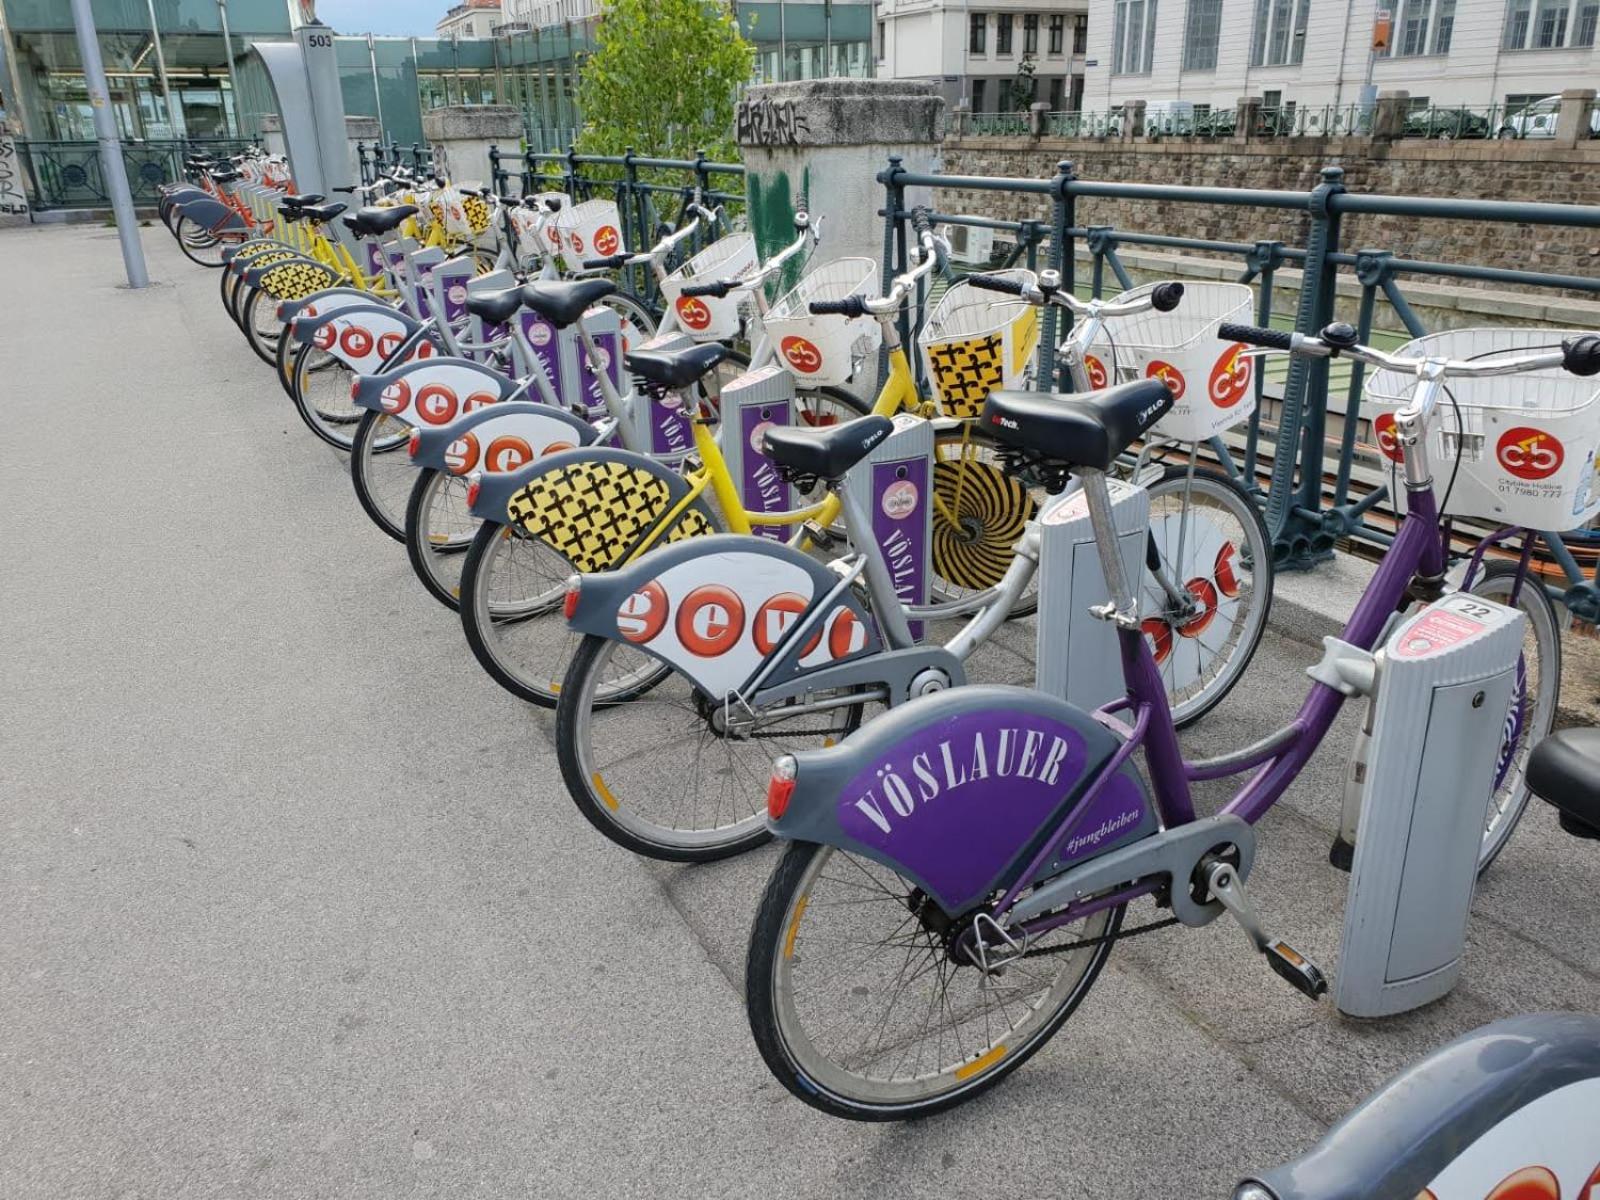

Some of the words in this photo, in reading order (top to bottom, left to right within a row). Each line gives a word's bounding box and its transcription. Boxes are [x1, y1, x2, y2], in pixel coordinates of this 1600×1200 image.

[309, 35, 332, 48] 503
[1498, 484, 1511, 493] 01
[1542, 490, 1562, 499] 777
[1459, 603, 1490, 618] 22
[855, 728, 1068, 834] VÖSLAUER
[1066, 808, 1140, 855] #jungbleiben
